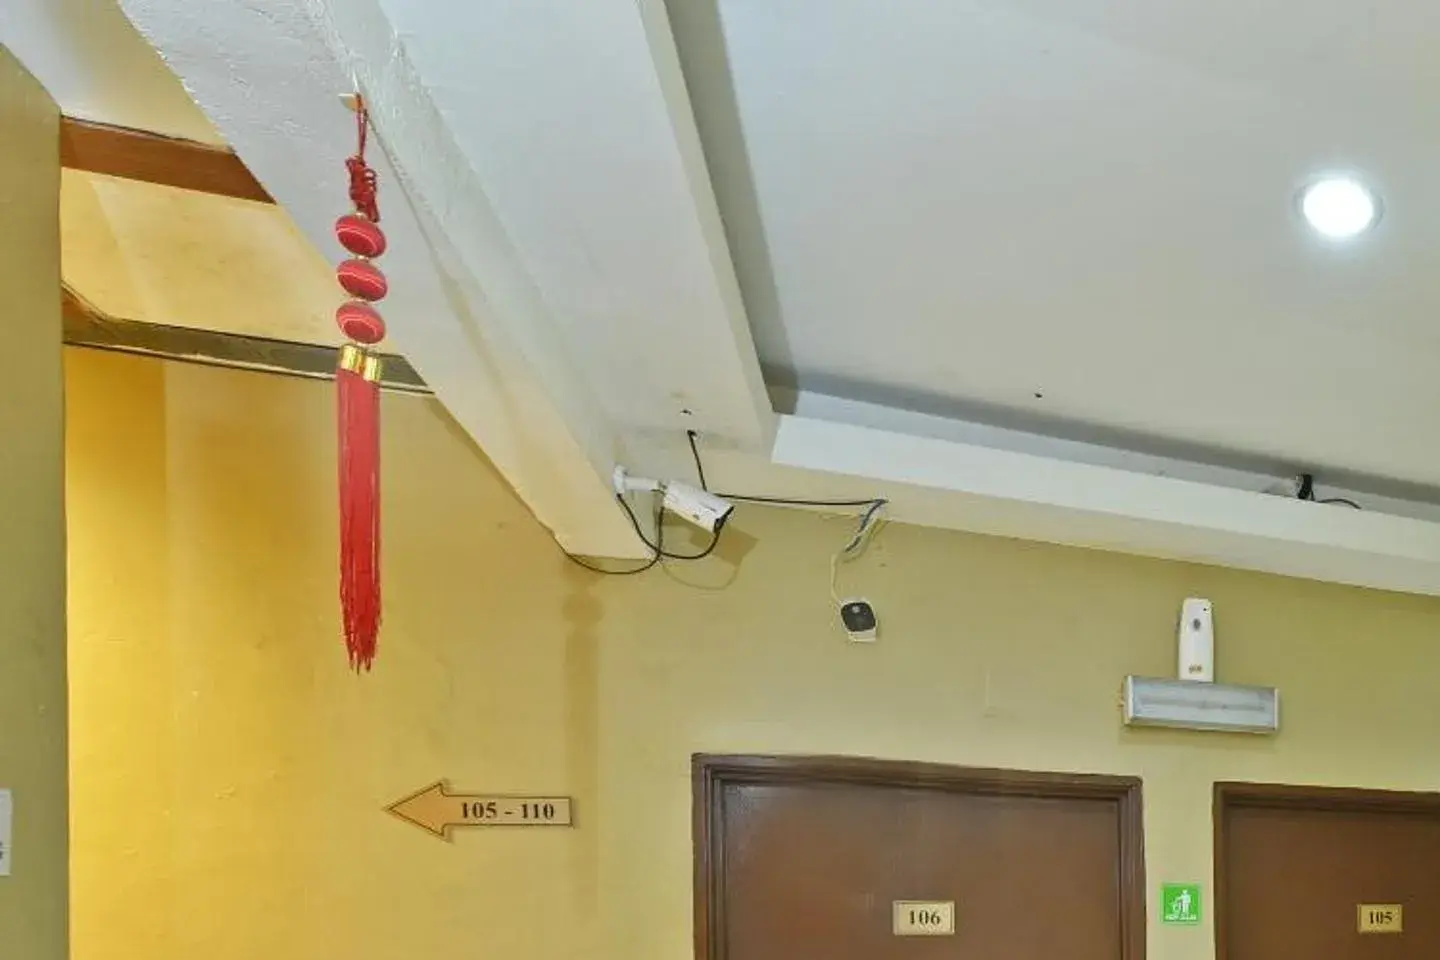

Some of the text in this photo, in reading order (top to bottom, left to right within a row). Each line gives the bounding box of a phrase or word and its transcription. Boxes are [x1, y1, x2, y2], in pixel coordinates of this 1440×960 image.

[460, 802, 498, 819] 105
[521, 803, 555, 819] 110
[909, 909, 941, 926] 106
